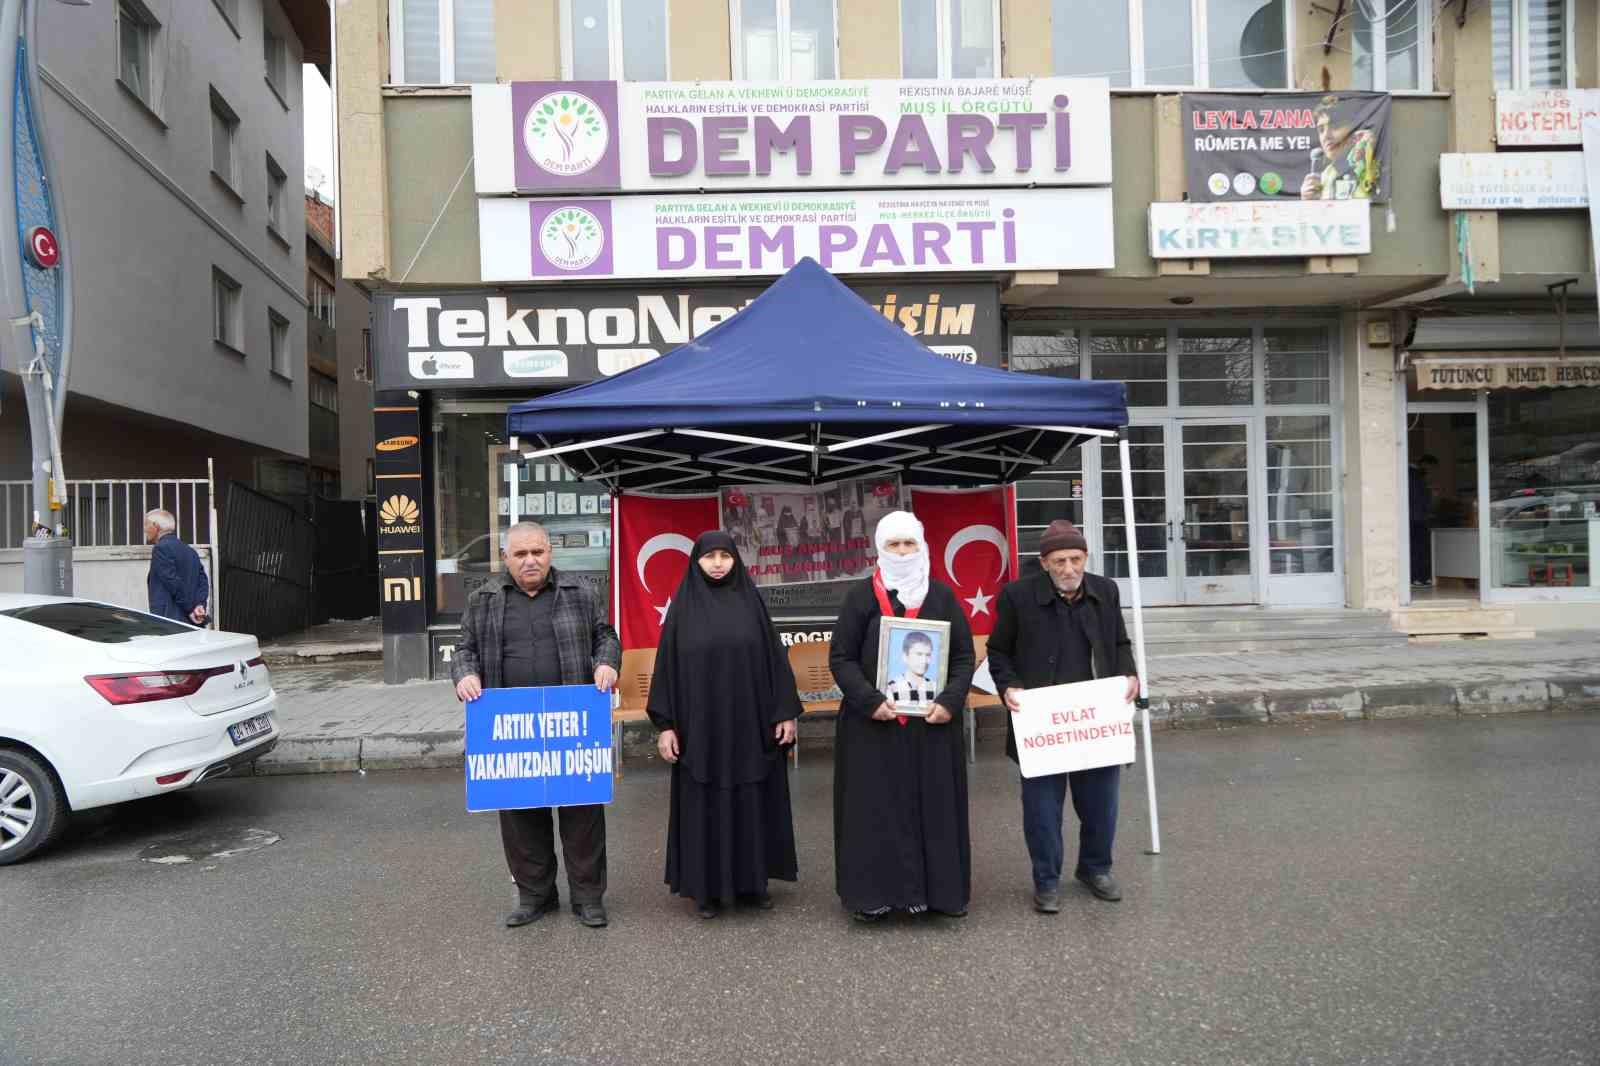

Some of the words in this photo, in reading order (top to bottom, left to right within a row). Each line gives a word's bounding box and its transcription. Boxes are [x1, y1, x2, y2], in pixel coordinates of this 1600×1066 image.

[646, 103, 706, 114] HALKLARIN
[751, 103, 764, 112] VE
[1193, 109, 1258, 130] LEYLA
[1260, 108, 1316, 128] ZANA
[646, 115, 812, 178] DEM
[838, 94, 1071, 176] PARTİ
[1194, 134, 1257, 152] RÛMETA
[1261, 138, 1284, 151] ME
[1286, 136, 1311, 150] YE!
[656, 215, 710, 225] HALKLARIN
[655, 224, 795, 270] DEM
[819, 208, 1017, 269] PARTİ
[393, 294, 758, 347] TeknoNe
[380, 526, 420, 534] HUAWEI
[492, 713, 535, 741] ARTIK
[538, 711, 579, 738] YETER
[583, 710, 588, 736] !
[1052, 707, 1096, 725] EVLAT
[468, 750, 561, 781] YAKAMIZDAN
[565, 742, 612, 782] DÜŞÜN
